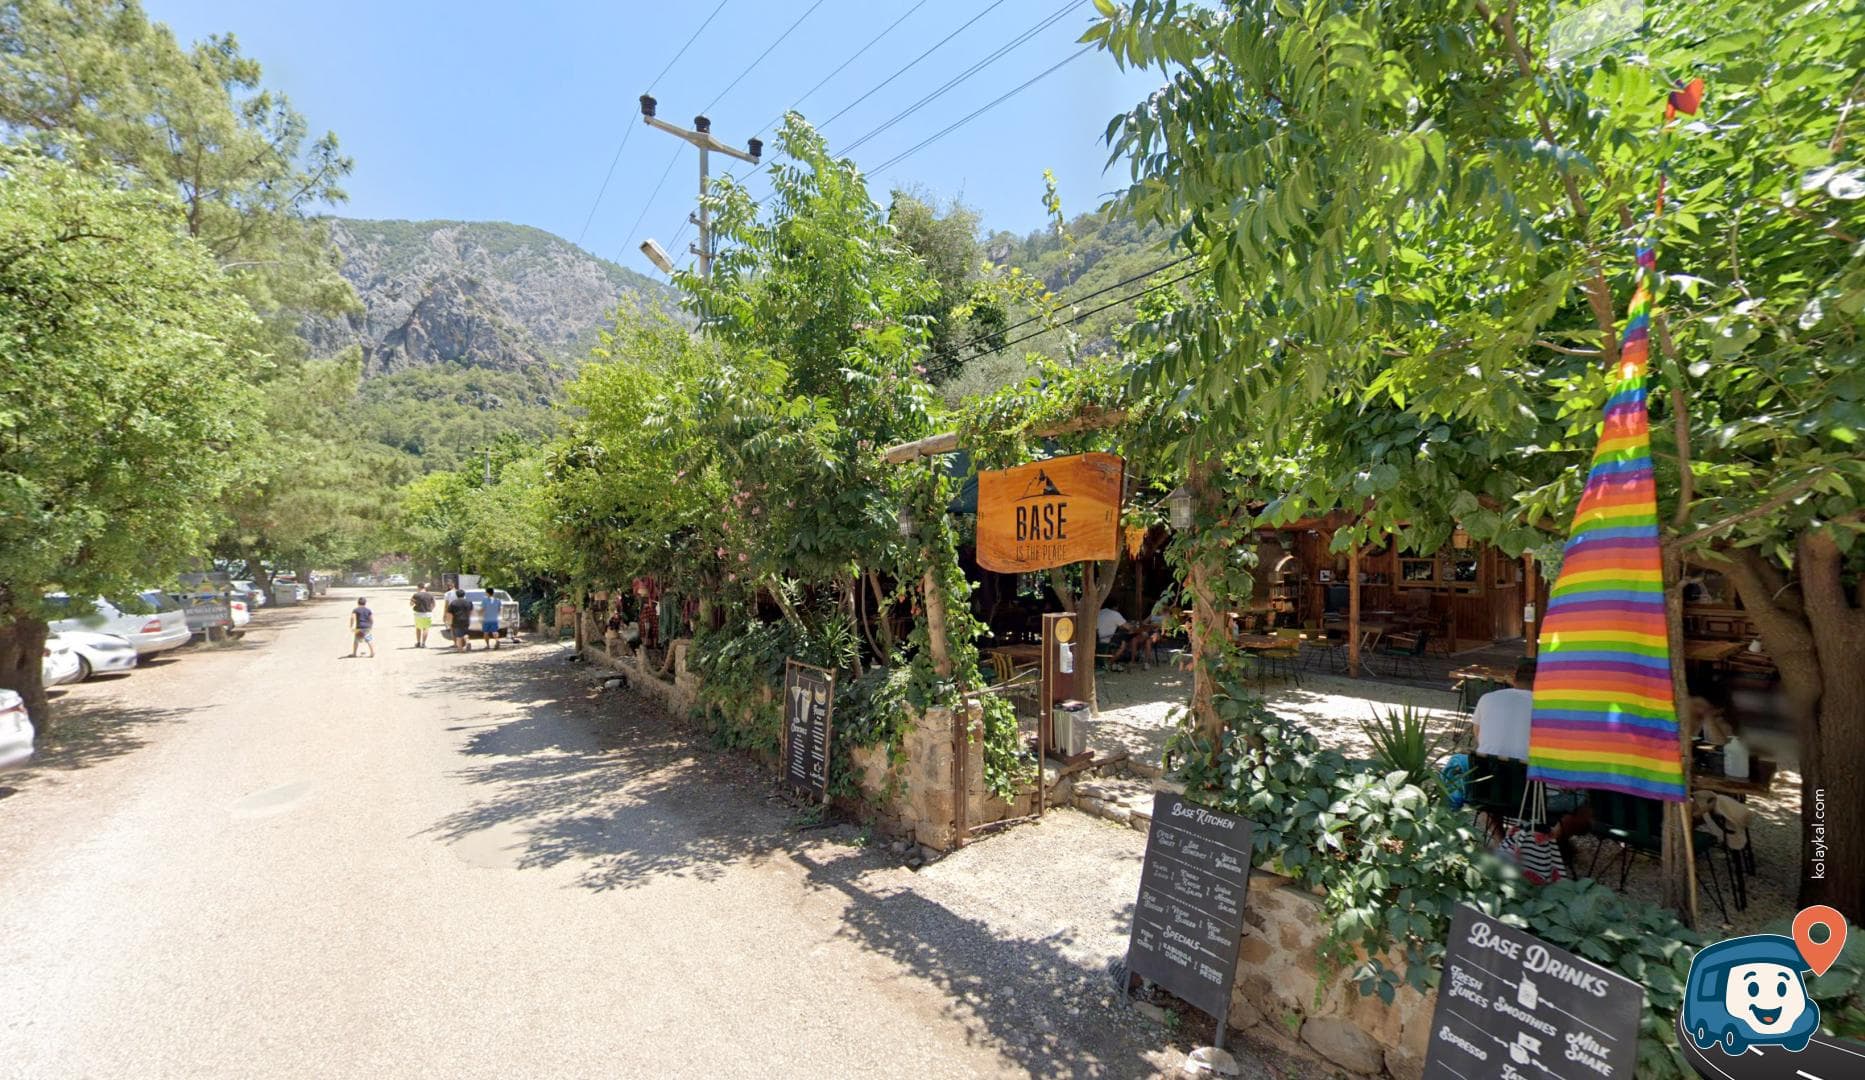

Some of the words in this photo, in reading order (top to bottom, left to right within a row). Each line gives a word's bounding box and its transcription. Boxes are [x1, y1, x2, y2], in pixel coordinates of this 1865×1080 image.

[1016, 502, 1068, 541] BASE
[1026, 545, 1039, 561] THE
[1042, 544, 1066, 561] PLACE
